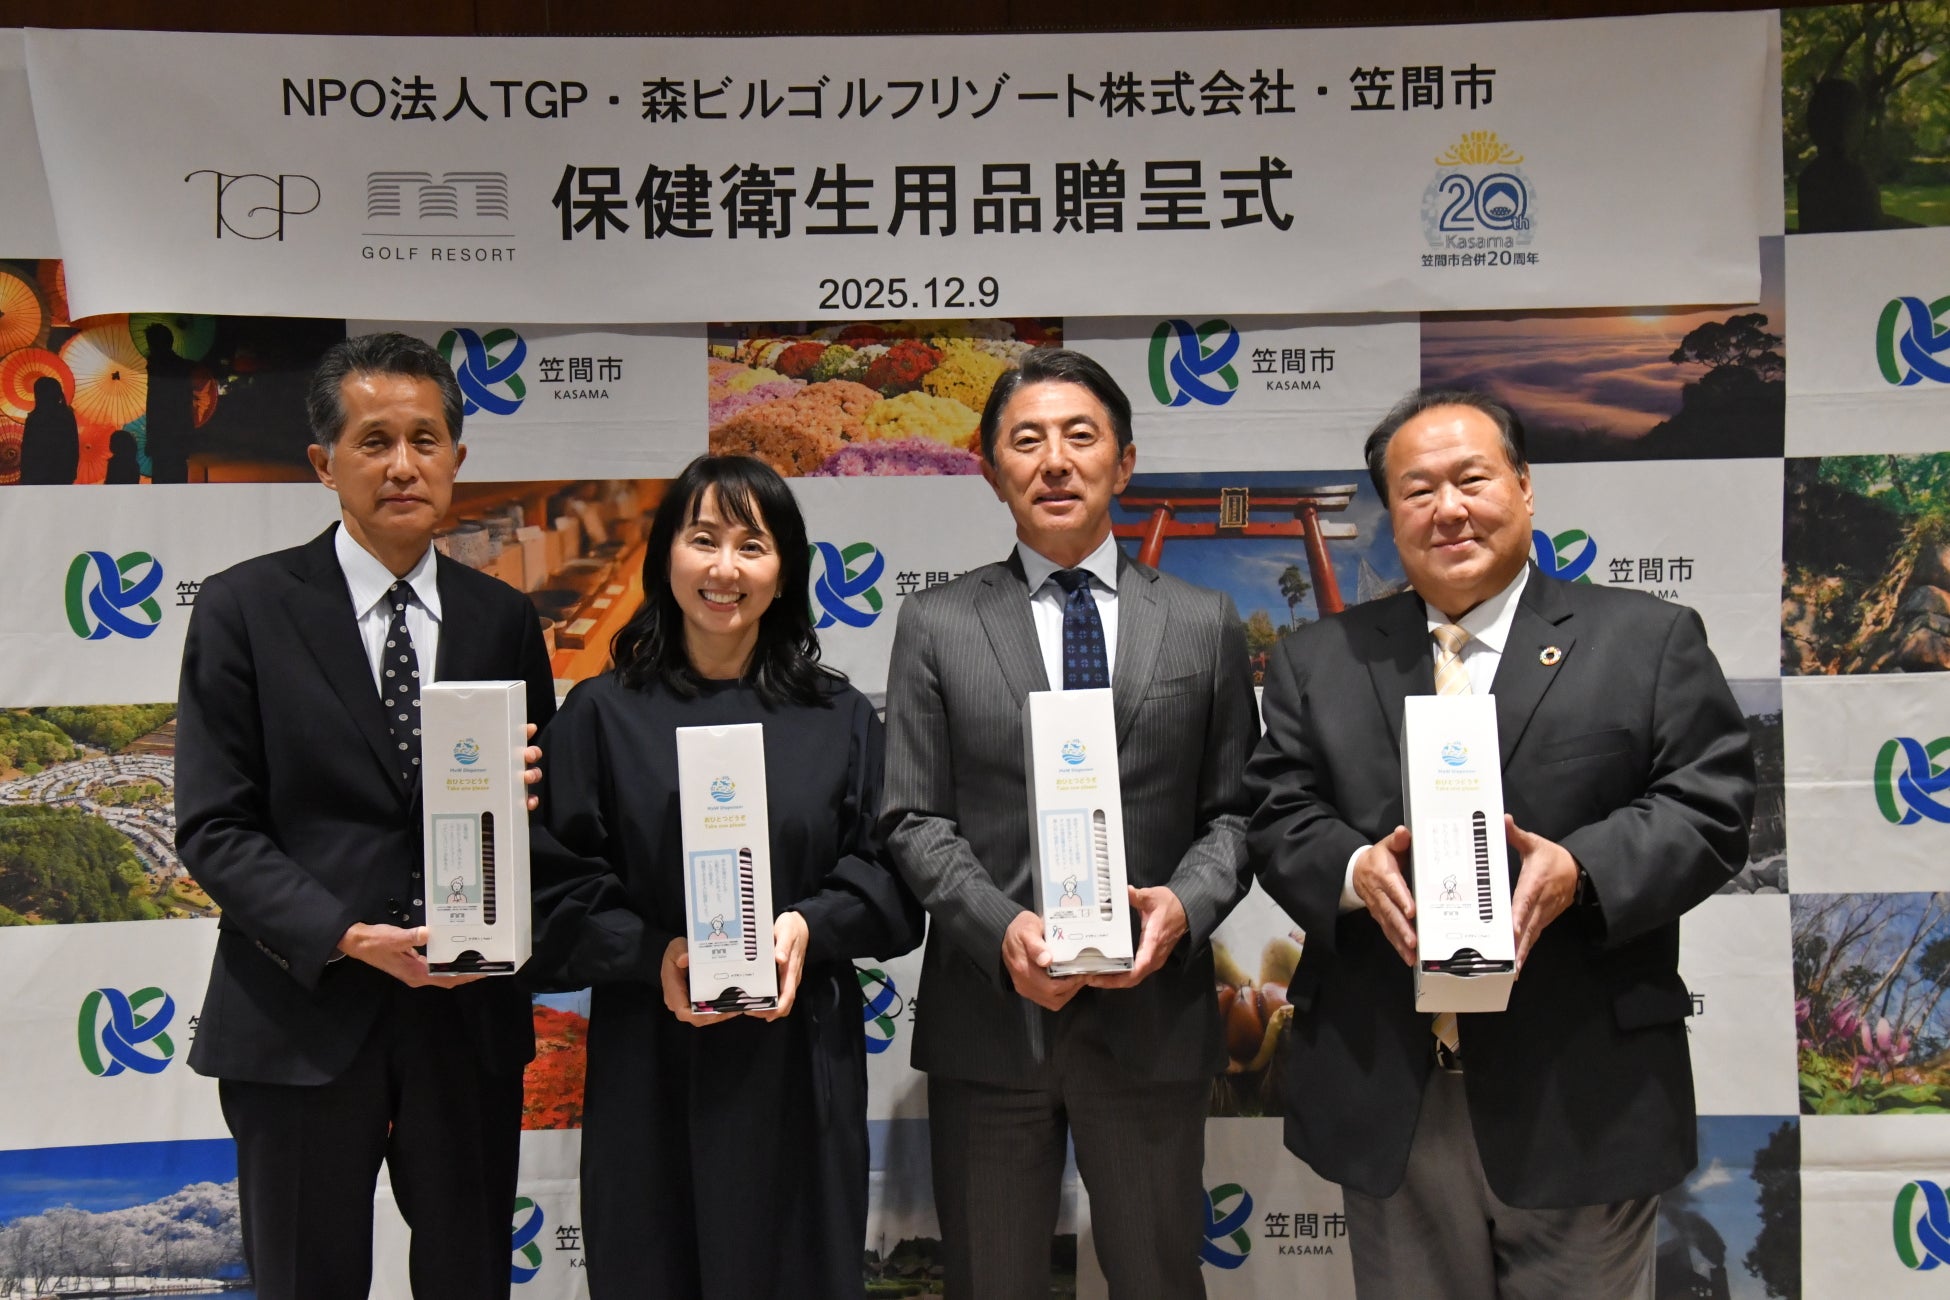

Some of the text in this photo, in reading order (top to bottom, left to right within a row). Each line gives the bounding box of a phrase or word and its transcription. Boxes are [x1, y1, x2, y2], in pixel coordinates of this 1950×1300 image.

[282, 62, 1497, 123] NPO法人TGP・森ビルゴルフリゾート株式会社・笠間市
[184, 169, 321, 242] TGP
[551, 155, 1295, 241] 保健衛生用品贈呈式
[362, 246, 516, 262] GOLF RESORT
[1421, 251, 1539, 267] 笠間市合併20周年
[819, 276, 999, 310] 2025.12.9
[538, 355, 624, 384] 笠間市
[1251, 347, 1336, 374] 笠間市
[554, 389, 609, 400] KASAMA
[1266, 380, 1321, 391] KASAMA
[1608, 556, 1694, 583] 笠間市
[1264, 1212, 1347, 1239] 笠間市
[1279, 1245, 1334, 1256] KASAMA
